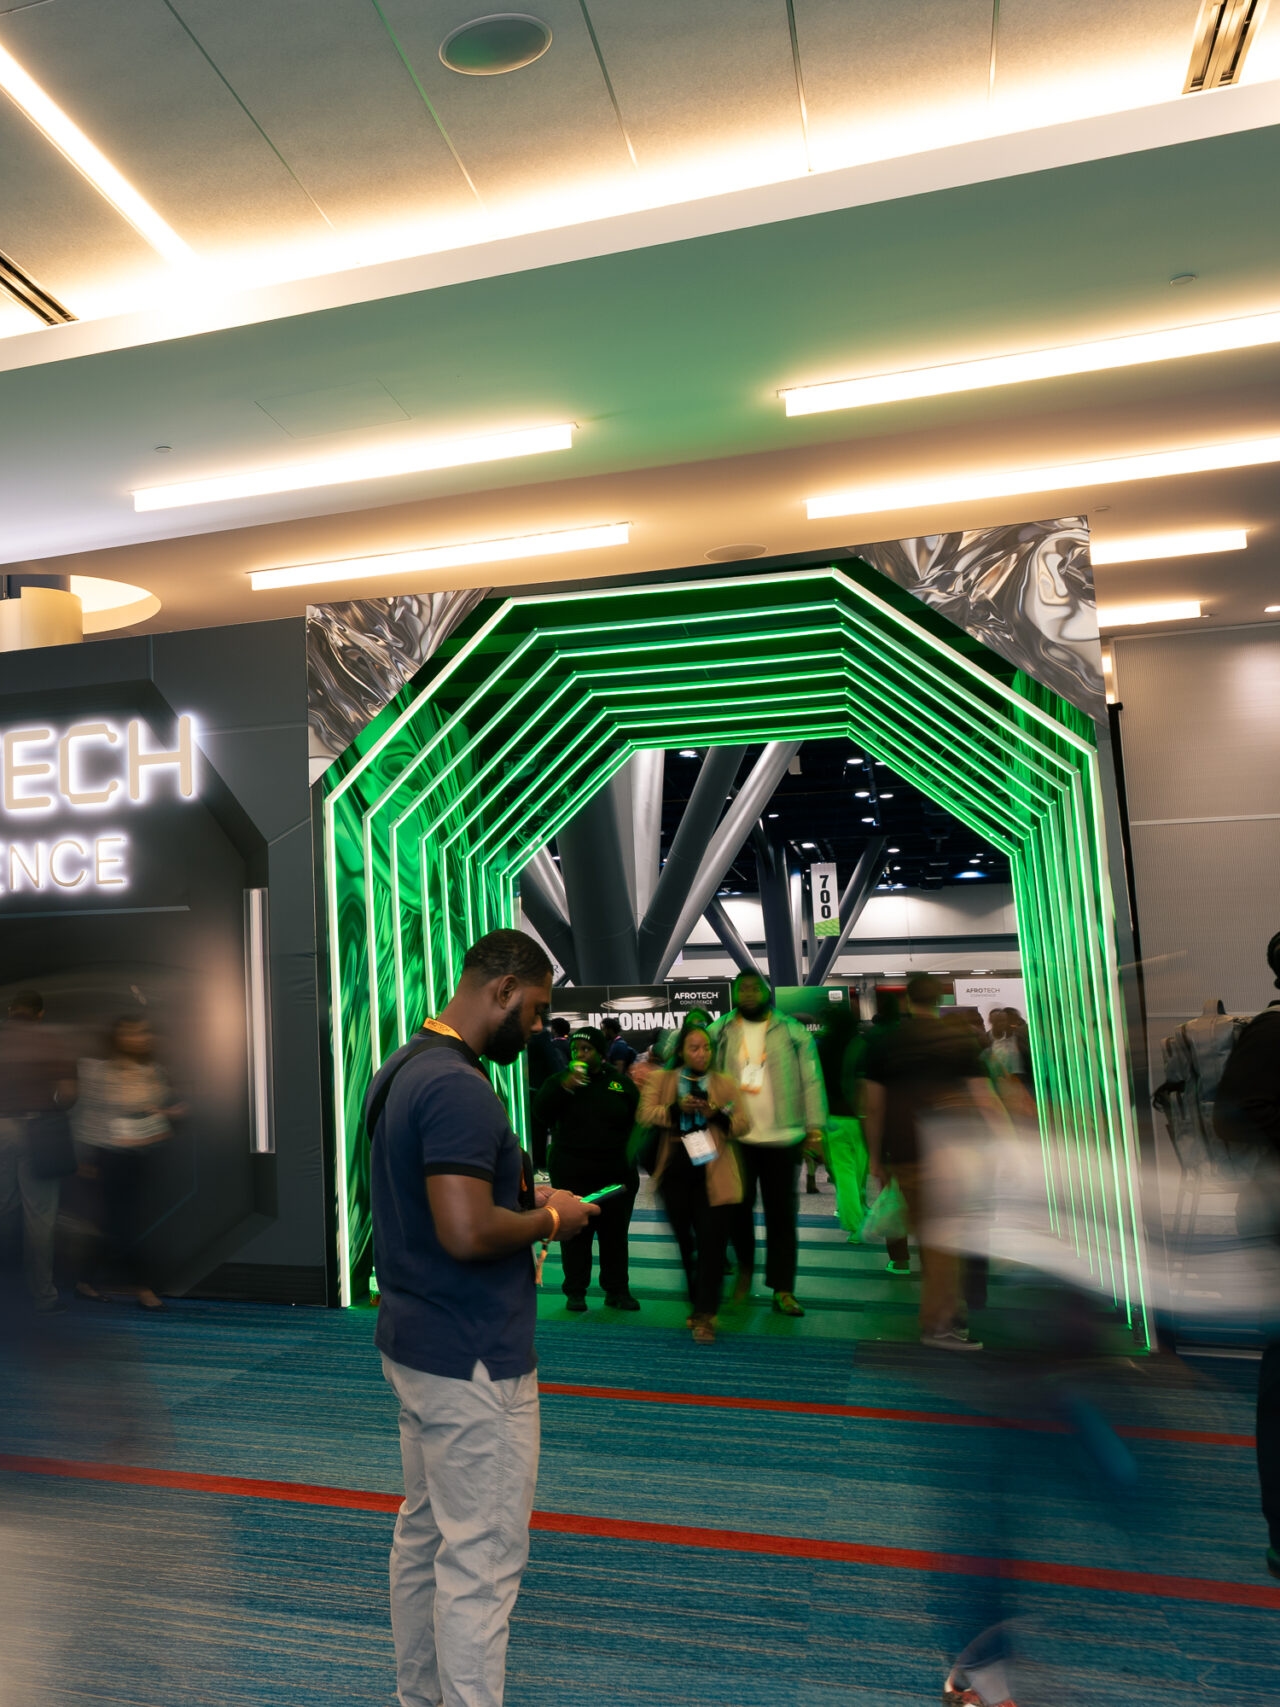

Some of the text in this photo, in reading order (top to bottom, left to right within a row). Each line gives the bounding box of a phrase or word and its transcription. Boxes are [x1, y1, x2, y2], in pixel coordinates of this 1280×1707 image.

[819, 874, 832, 919] 700
[674, 991, 719, 1000] AFROTECH
[588, 1010, 721, 1031] INORMAT
